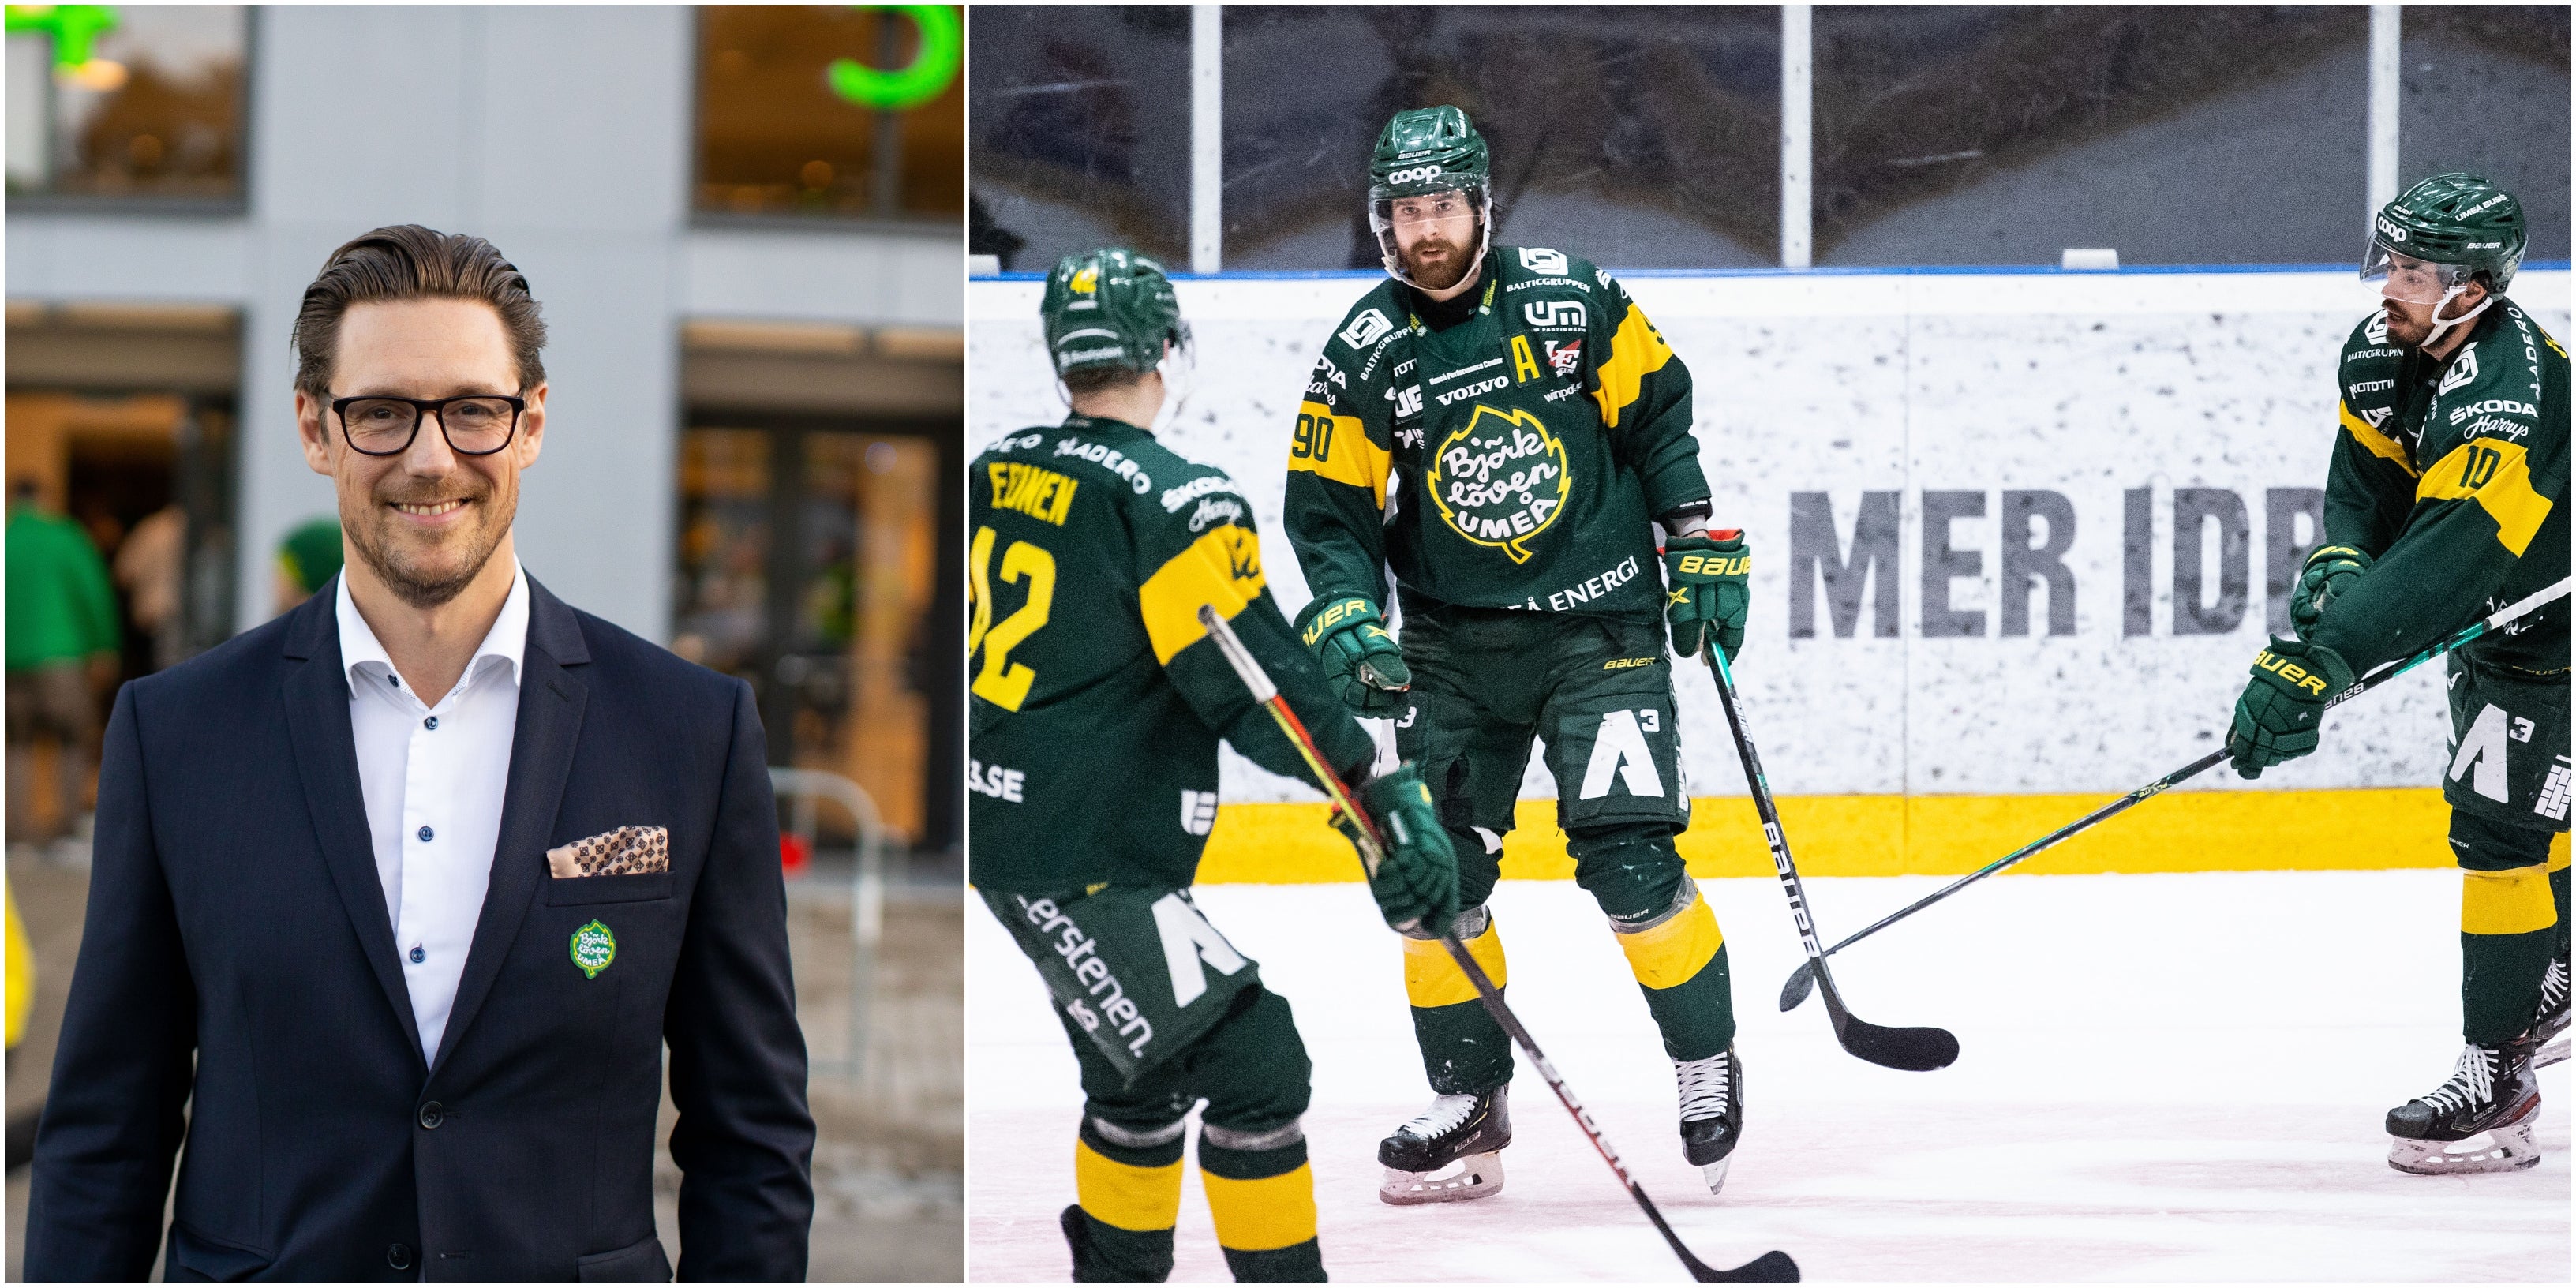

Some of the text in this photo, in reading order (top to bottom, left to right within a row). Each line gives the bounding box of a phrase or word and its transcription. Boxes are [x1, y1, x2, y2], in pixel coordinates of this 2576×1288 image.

[1388, 165, 1442, 185] coop
[2377, 216, 2407, 242] coop
[1511, 335, 1541, 384] A
[1435, 376, 1510, 406] VOLVO
[2449, 399, 2539, 426] ŠKODA
[2464, 415, 2529, 442] Harrys
[1292, 412, 1335, 463] 90
[1441, 429, 1546, 483] Björk
[1447, 462, 1559, 507] löven
[2458, 445, 2502, 489] 10
[1458, 491, 1559, 539] UMEÅ
[1788, 489, 2076, 639] MER
[1548, 555, 1640, 612] ENERGI
[1603, 657, 1657, 670] BAUER
[1762, 820, 1822, 960] BAUER
[578, 943, 610, 954] löven
[580, 931, 609, 945] Björk
[578, 953, 607, 966] UMEÅ
